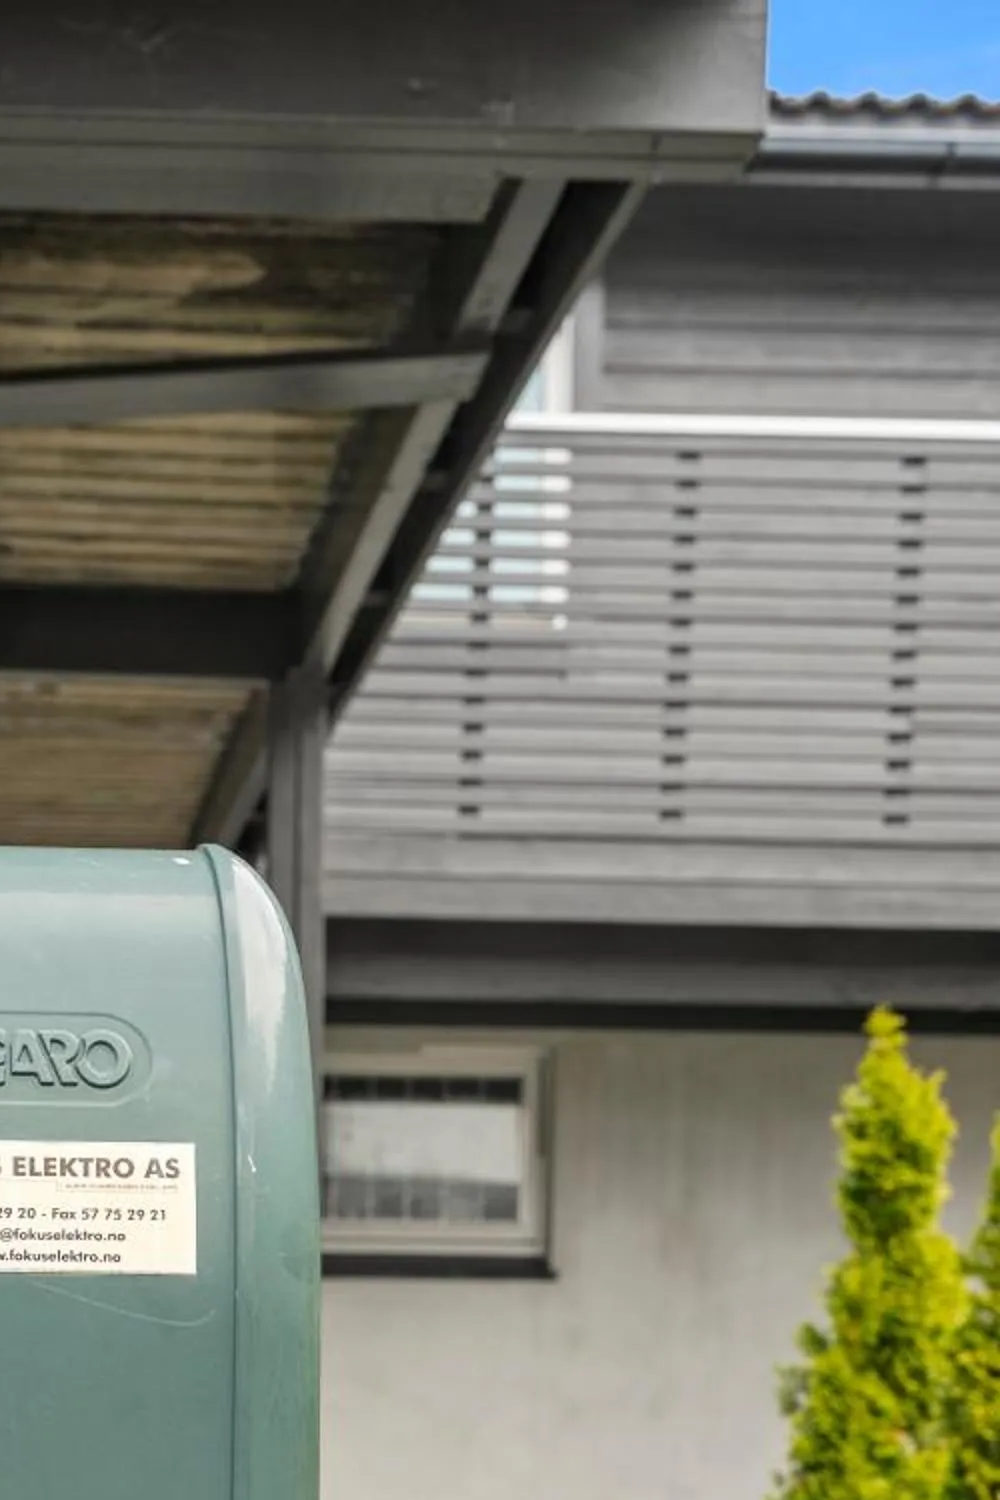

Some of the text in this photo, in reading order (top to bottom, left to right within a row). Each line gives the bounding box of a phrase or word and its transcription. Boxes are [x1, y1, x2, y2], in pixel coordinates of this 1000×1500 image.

[12, 1156, 135, 1178] ELEKTRO
[144, 1157, 180, 1179] AS
[18, 1207, 36, 1219] 20
[52, 1208, 76, 1220] Fax
[81, 1208, 99, 1220] 57
[104, 1208, 122, 1221] 75
[127, 1208, 145, 1221] 29
[150, 1209, 166, 1221] 21
